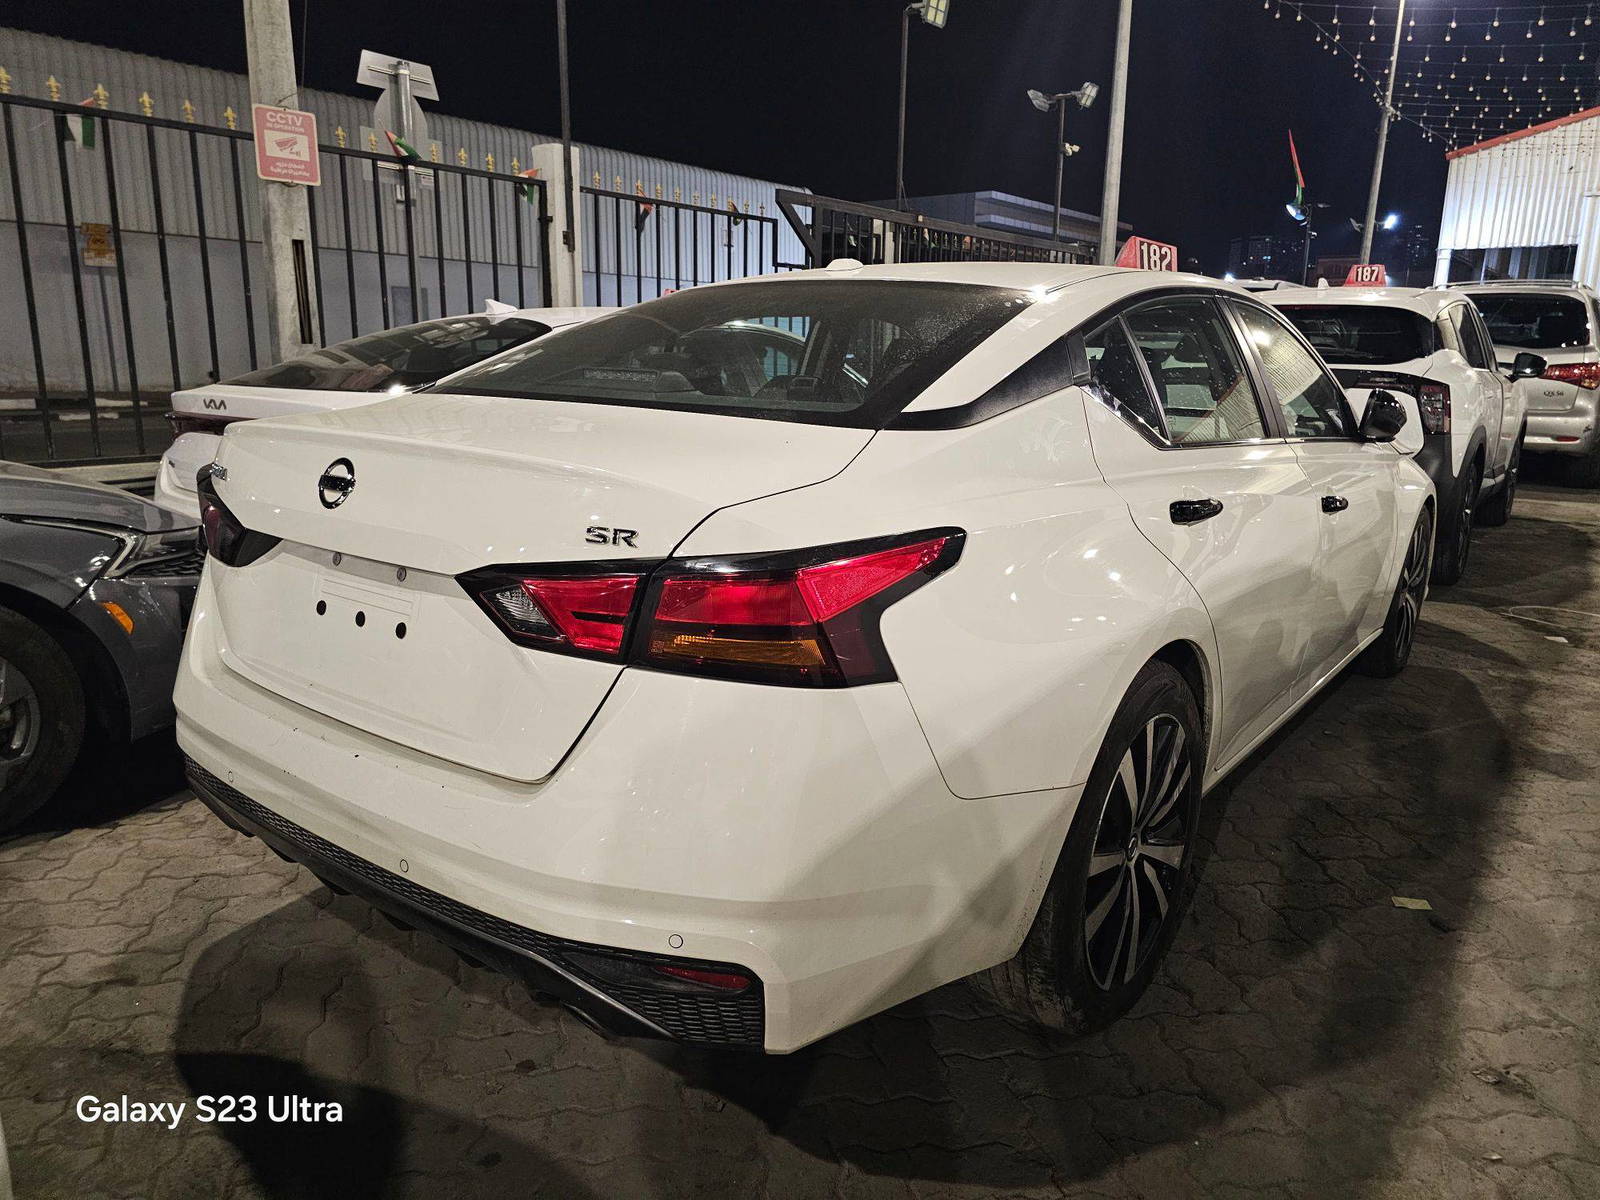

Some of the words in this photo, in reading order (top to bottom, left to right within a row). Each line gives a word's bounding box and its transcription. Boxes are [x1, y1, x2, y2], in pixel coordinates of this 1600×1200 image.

[266, 111, 303, 126] CCTV
[1141, 242, 1171, 272] 182
[1357, 266, 1379, 282] 187
[202, 398, 227, 410] KIA
[585, 526, 639, 548] SR
